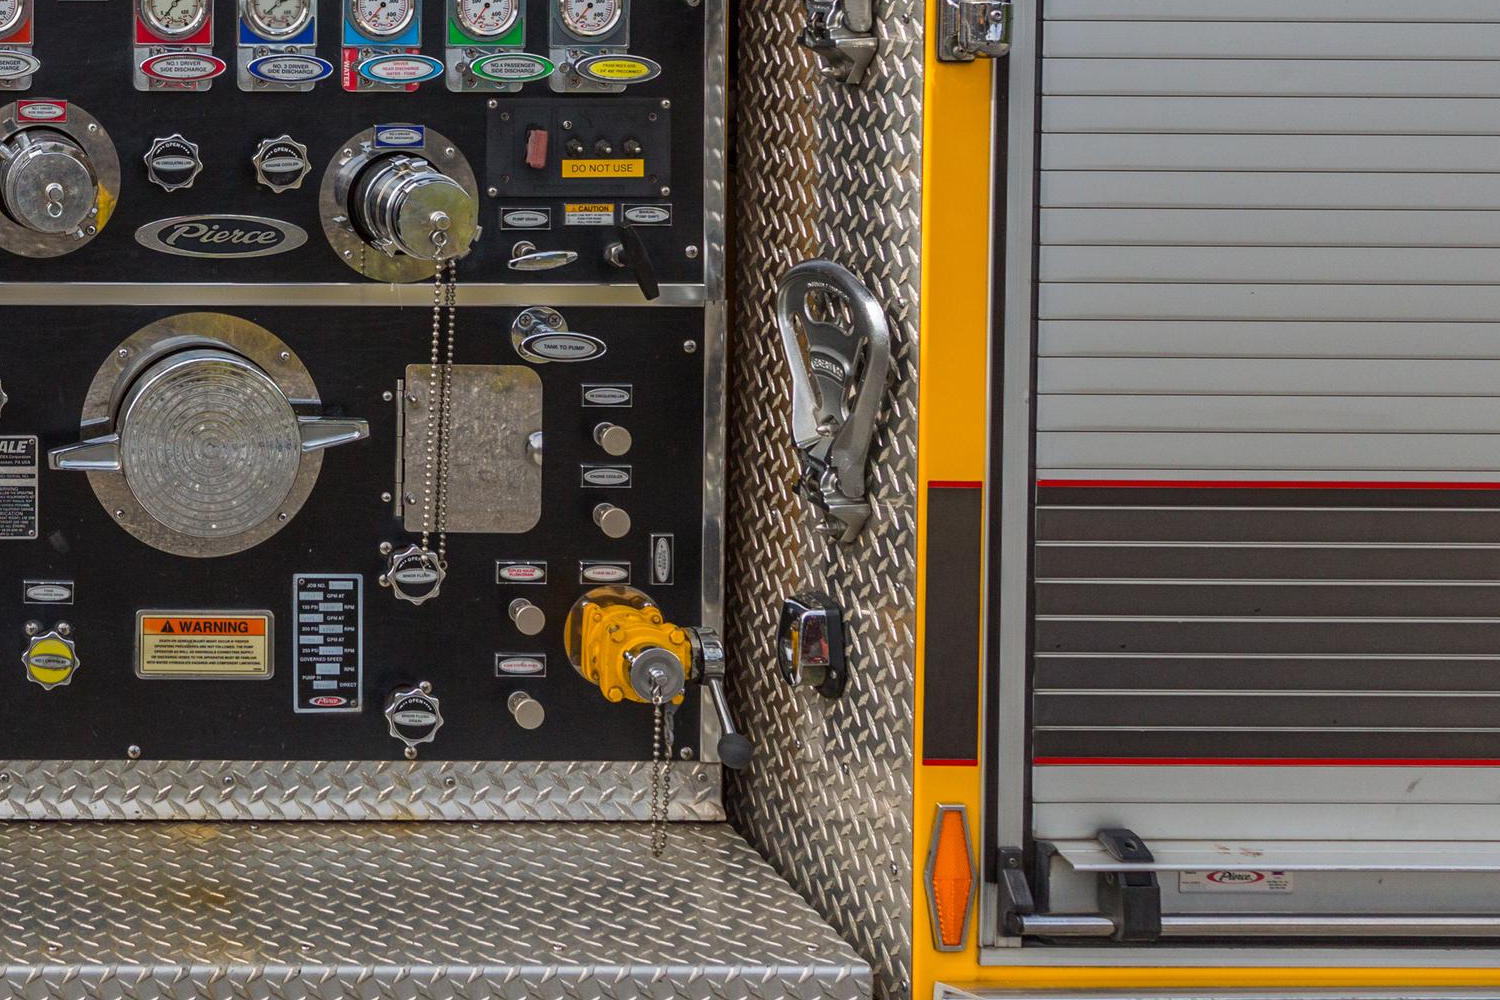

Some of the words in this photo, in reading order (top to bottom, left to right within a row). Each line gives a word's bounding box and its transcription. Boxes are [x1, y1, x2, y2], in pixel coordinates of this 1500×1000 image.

[572, 164, 586, 172] DO
[589, 164, 610, 172] NOT
[614, 164, 633, 172] USE
[166, 223, 277, 246] Pierce
[180, 622, 248, 632] WARNING
